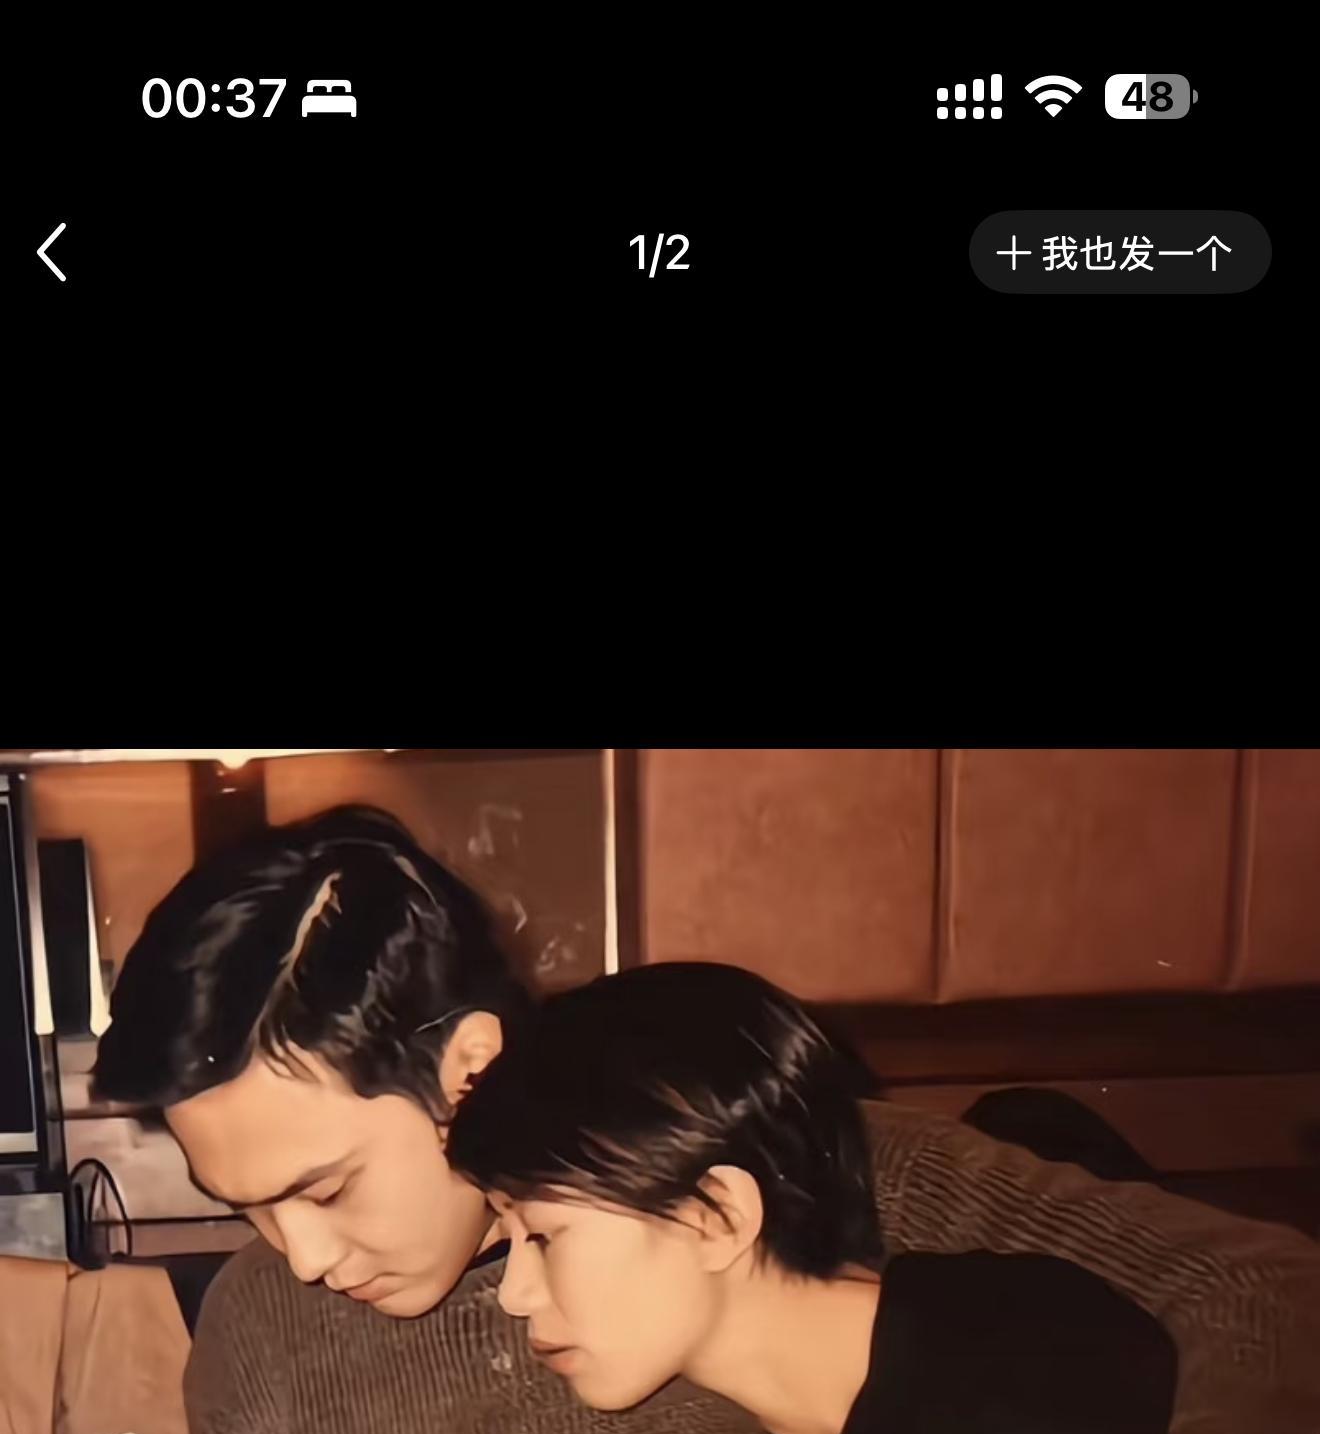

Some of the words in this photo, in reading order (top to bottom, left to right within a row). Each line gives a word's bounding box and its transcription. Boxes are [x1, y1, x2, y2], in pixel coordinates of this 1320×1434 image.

[141, 77, 287, 119] 00:37
[1121, 81, 1174, 112] 48
[629, 232, 691, 279] 1/2
[1041, 234, 1233, 272] 我也发一个
